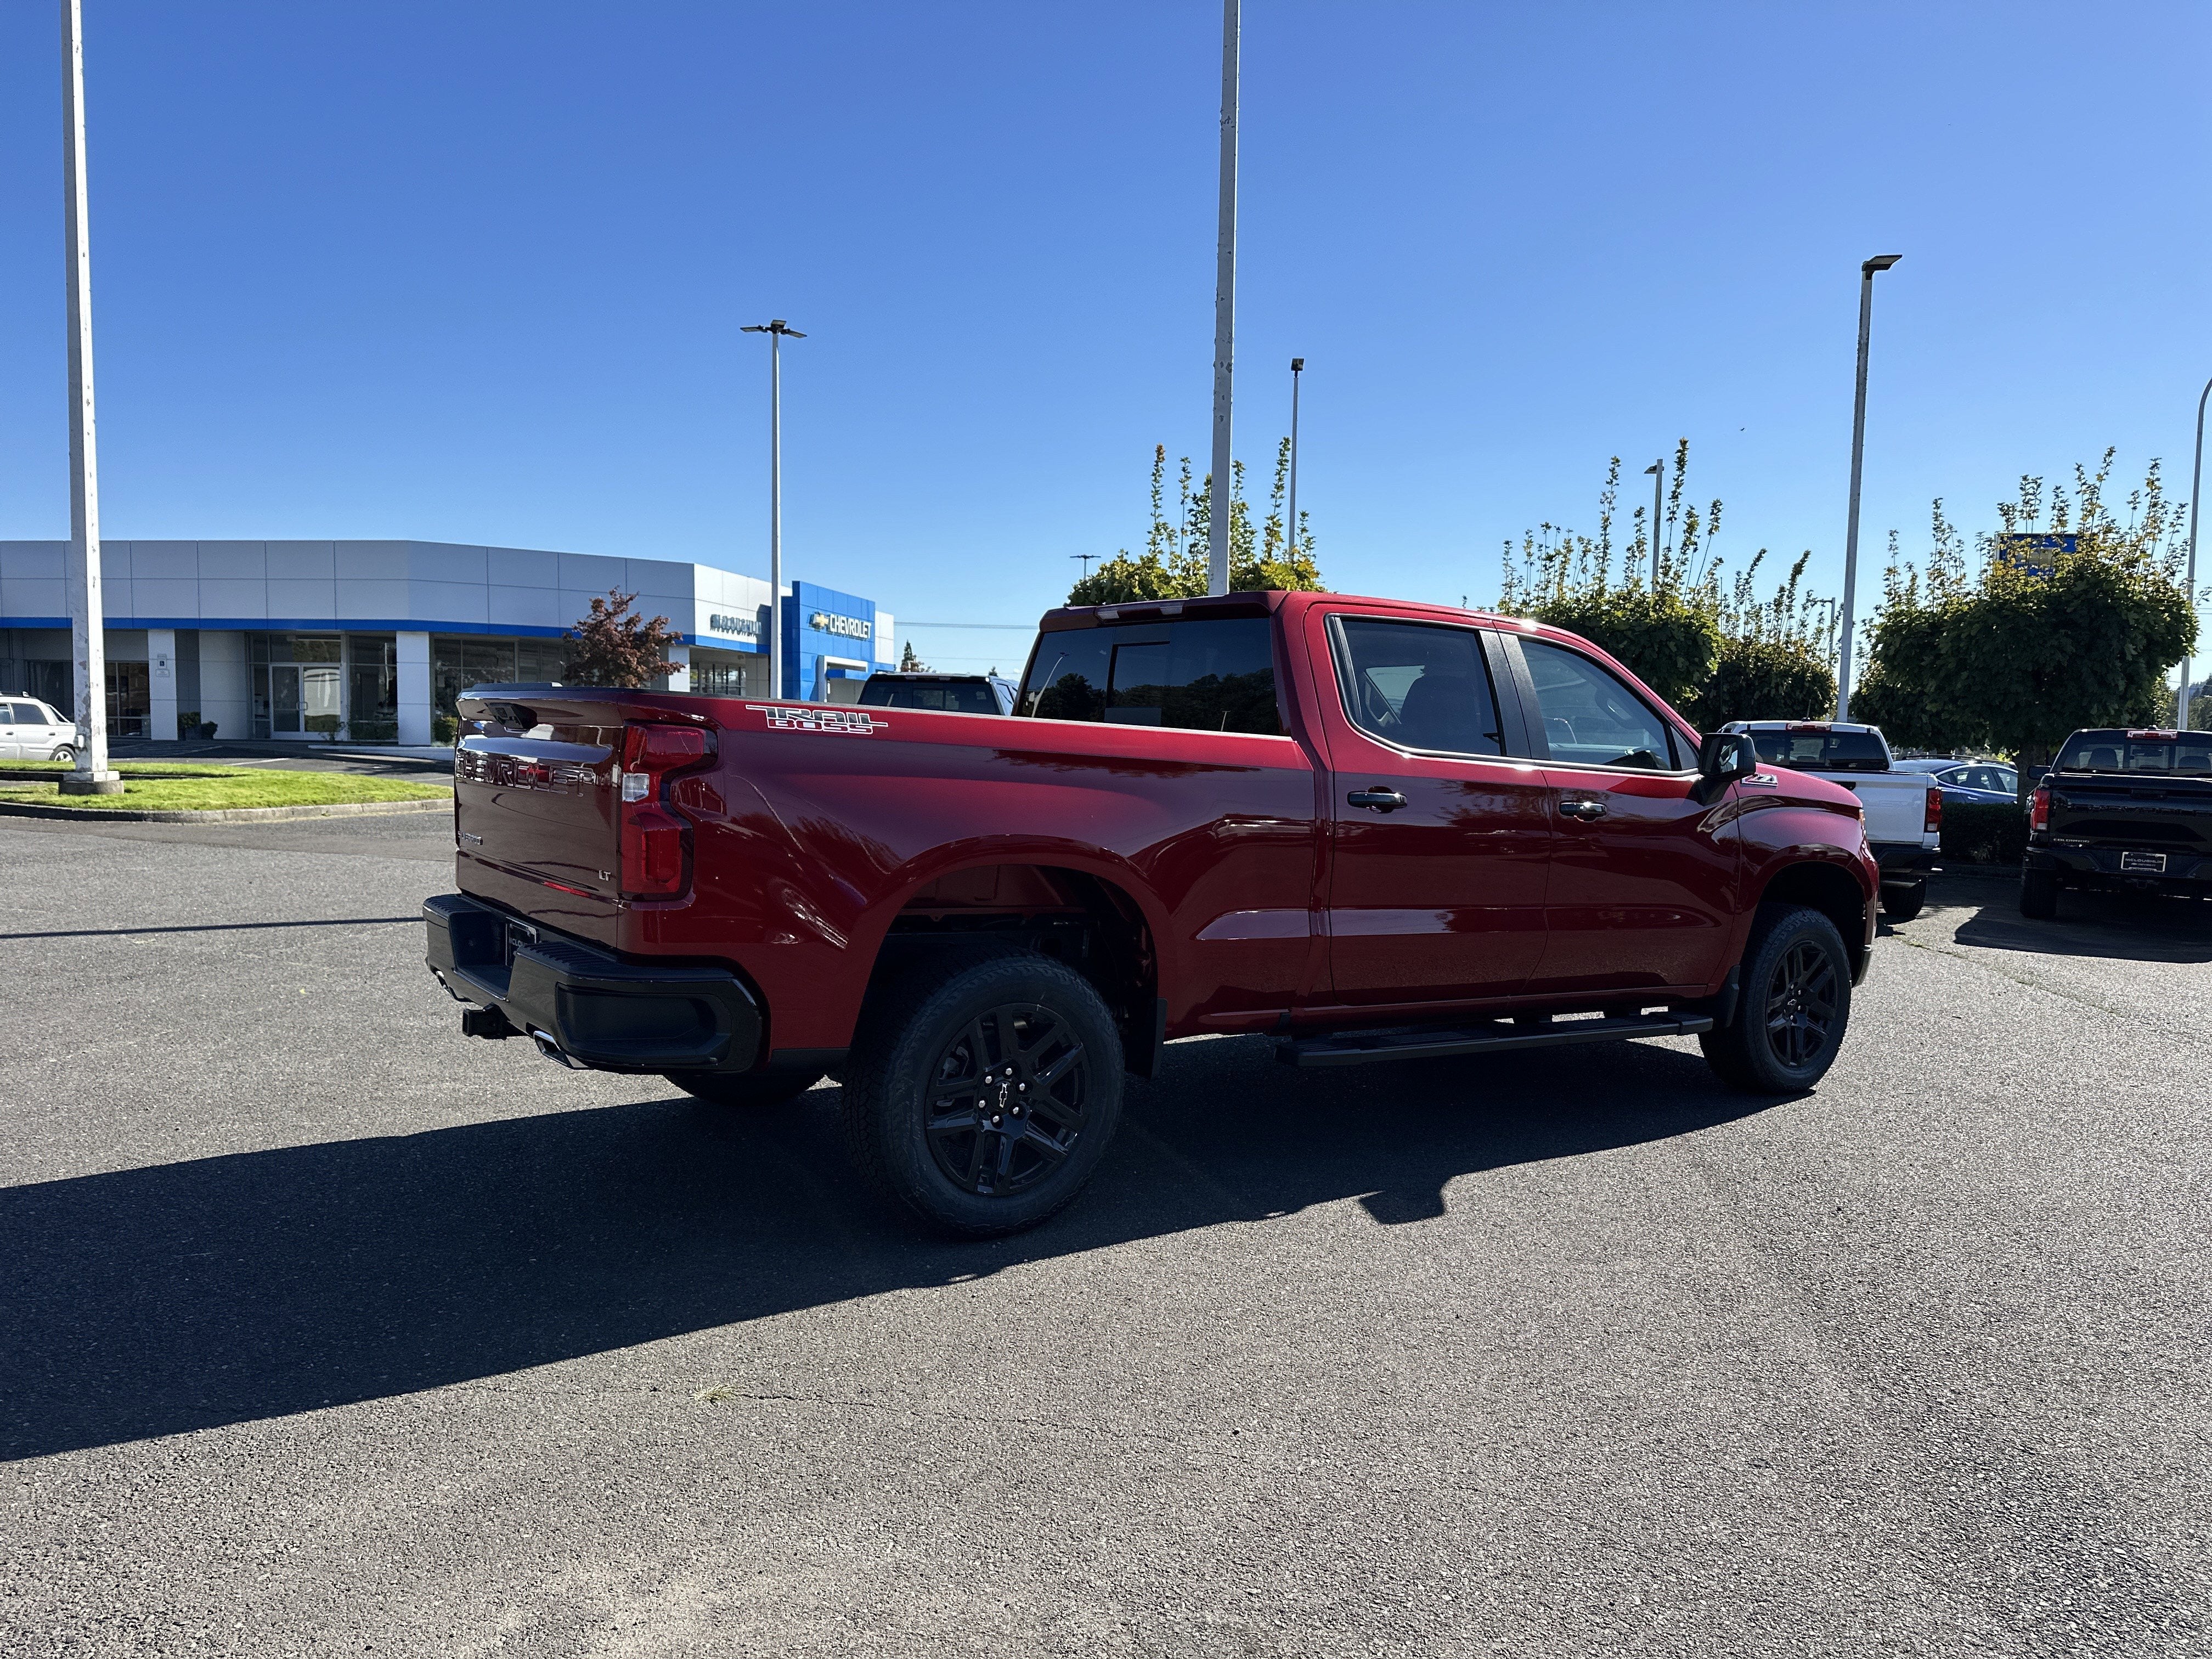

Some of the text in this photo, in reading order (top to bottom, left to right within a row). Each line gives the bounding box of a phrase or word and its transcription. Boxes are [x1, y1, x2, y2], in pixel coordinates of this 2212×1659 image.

[830, 614, 871, 639] CHEVROLET
[745, 704, 888, 727] TRAIL
[768, 718, 873, 735] BOSS
[599, 870, 611, 881] LT
